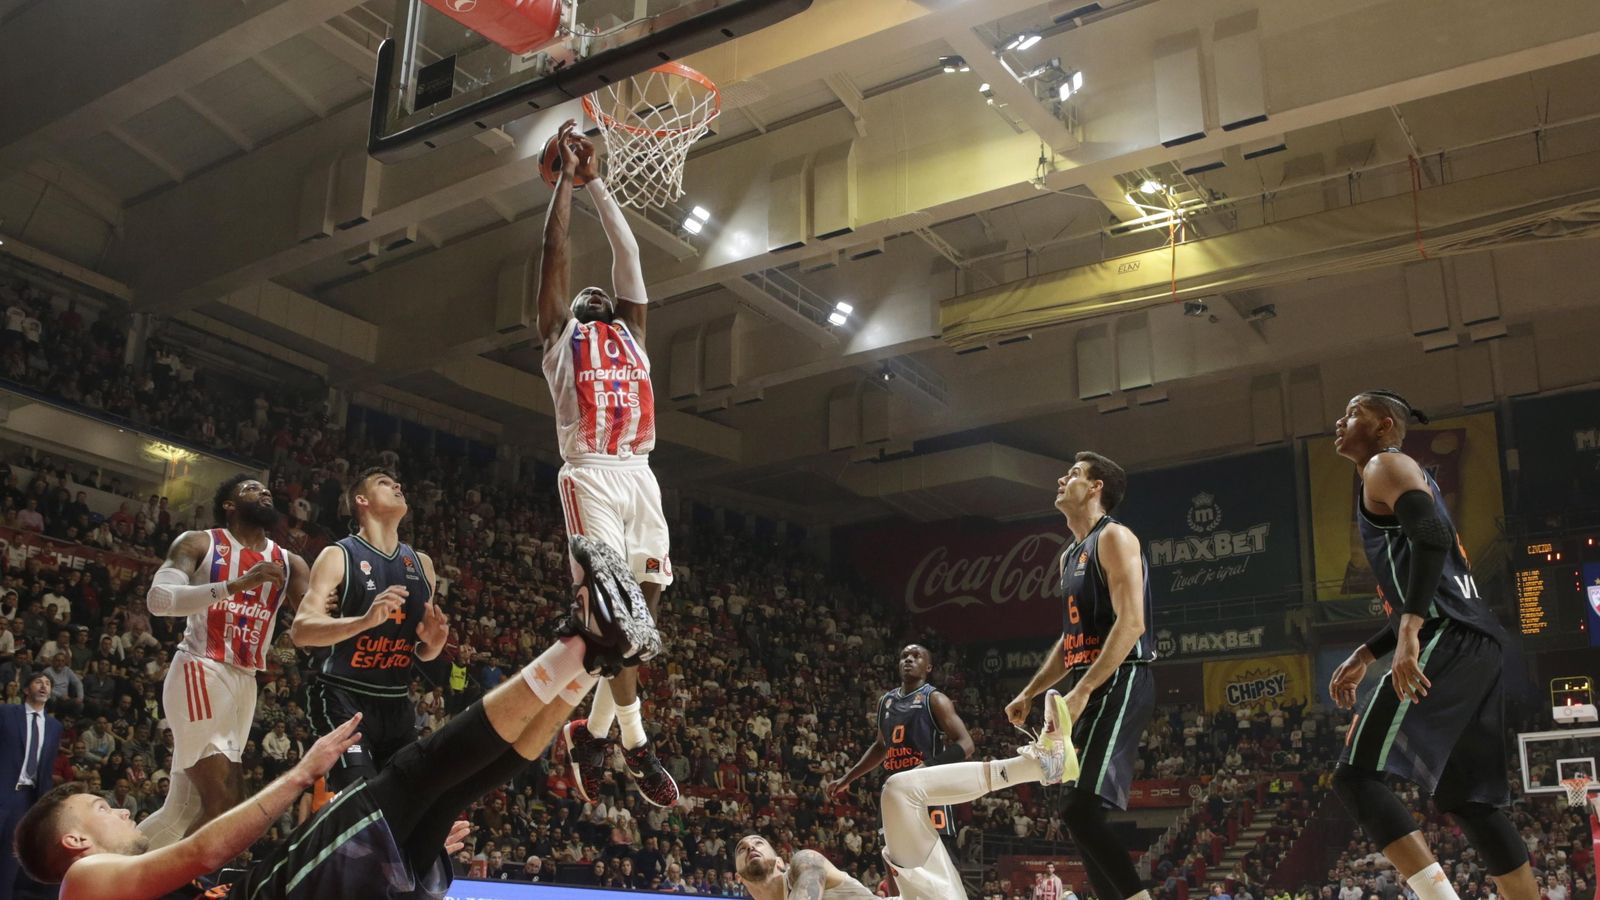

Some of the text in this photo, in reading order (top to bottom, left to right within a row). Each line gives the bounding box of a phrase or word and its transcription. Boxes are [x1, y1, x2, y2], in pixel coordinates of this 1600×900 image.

[1118, 262, 1141, 273] ELAN
[595, 388, 640, 408] mts
[1068, 595, 1080, 624] 6
[224, 624, 261, 645] mts
[892, 725, 905, 743] 0
